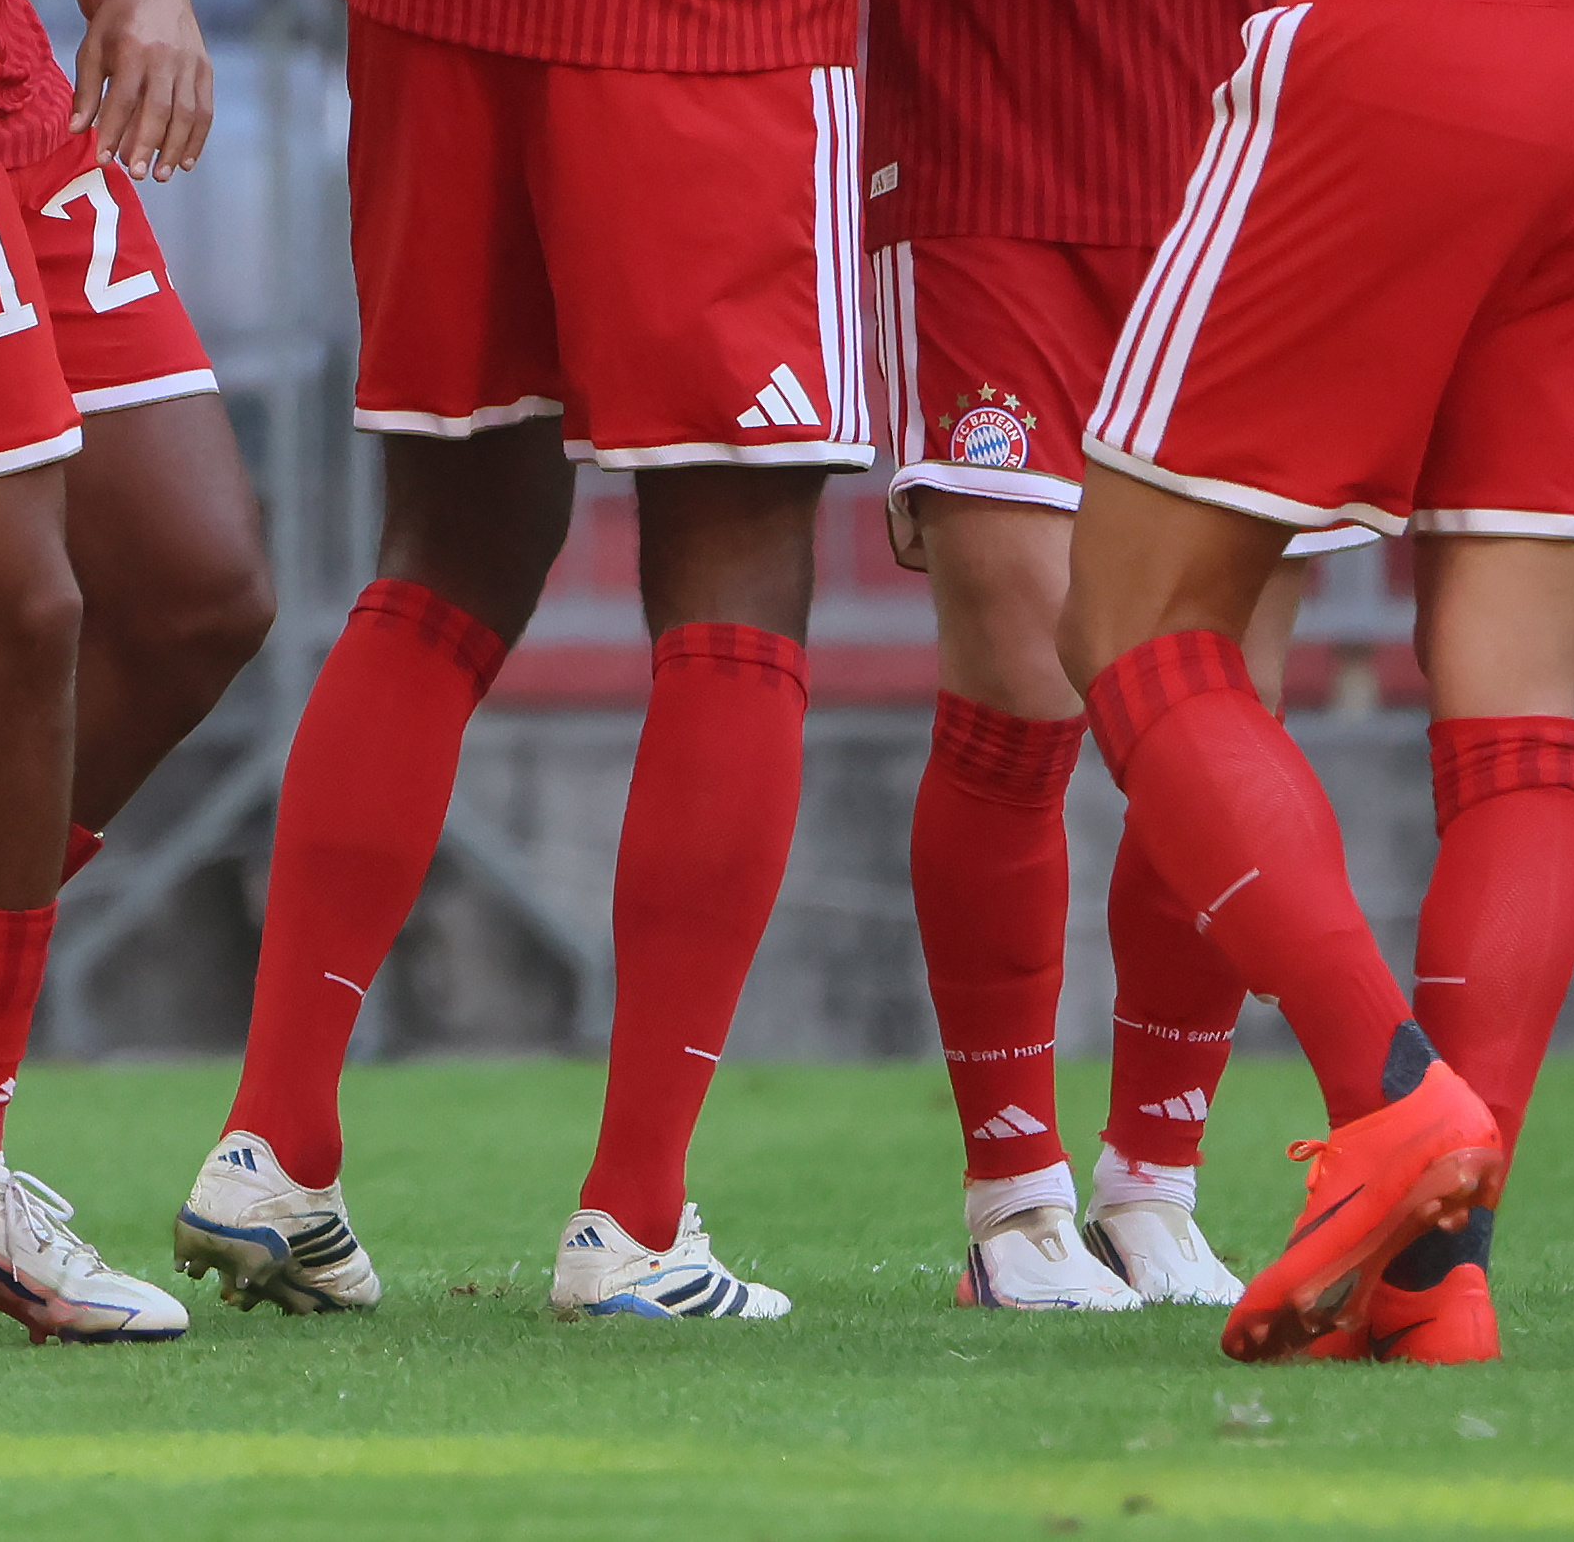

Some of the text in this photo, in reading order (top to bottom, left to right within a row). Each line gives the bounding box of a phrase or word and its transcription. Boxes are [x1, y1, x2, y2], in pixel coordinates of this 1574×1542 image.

[40, 167, 161, 315] 2
[955, 412, 1021, 443] FC BAYERN
[1146, 1023, 1180, 1041] MIA
[1187, 1031, 1221, 1042] SAN
[1014, 1043, 1043, 1059] MIA
